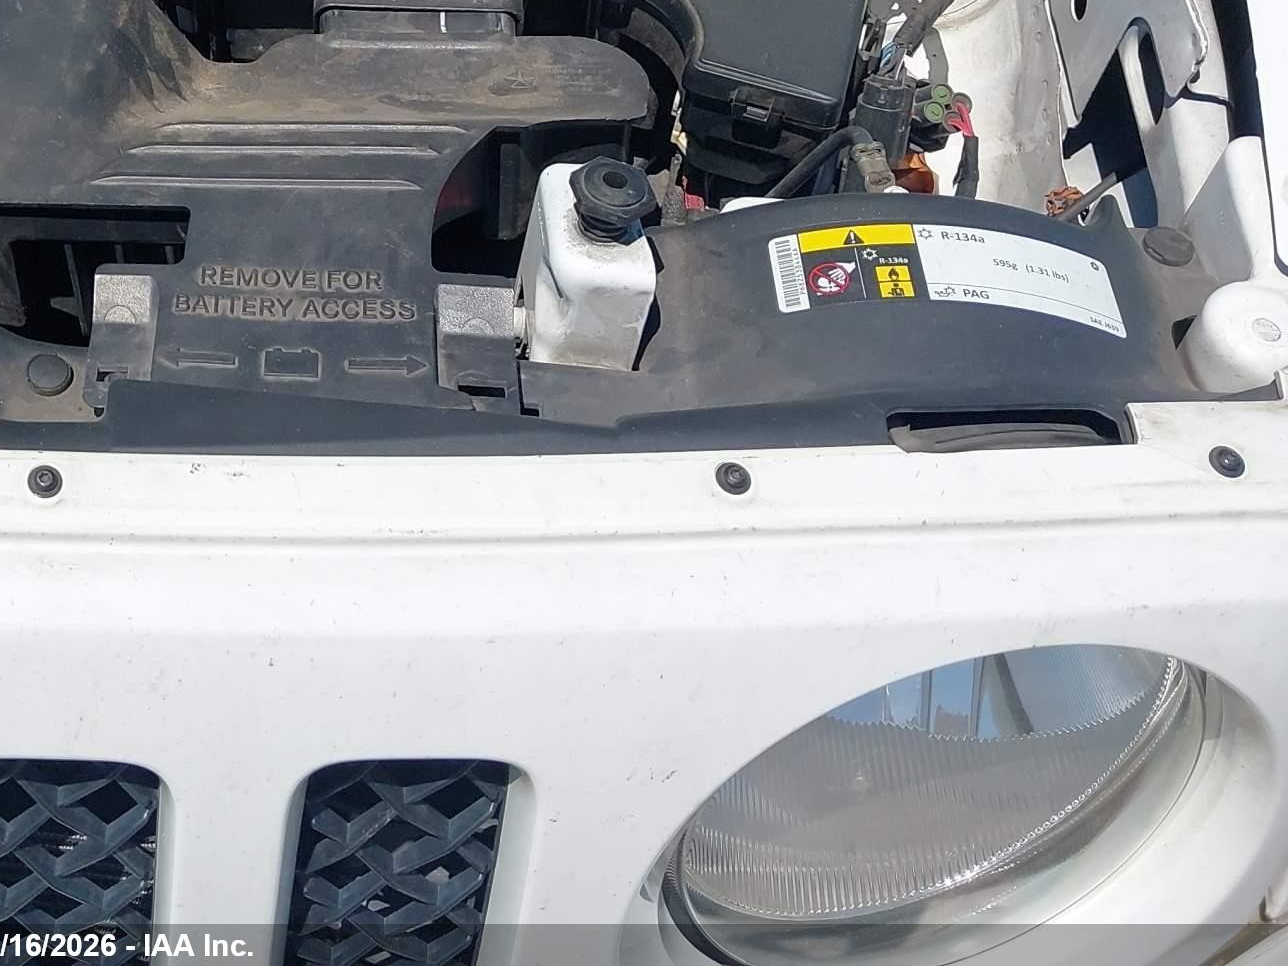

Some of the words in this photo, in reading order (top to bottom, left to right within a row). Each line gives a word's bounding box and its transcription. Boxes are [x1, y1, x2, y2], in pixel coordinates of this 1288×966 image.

[941, 231, 985, 243] R-134a
[200, 265, 317, 289] REMOVE
[327, 270, 383, 291] FOR
[993, 258, 1019, 271] 595g
[1052, 270, 1070, 283] lbs)
[963, 288, 990, 299] PAG
[174, 293, 294, 317] BATTERY
[302, 297, 417, 320] ACCESS
